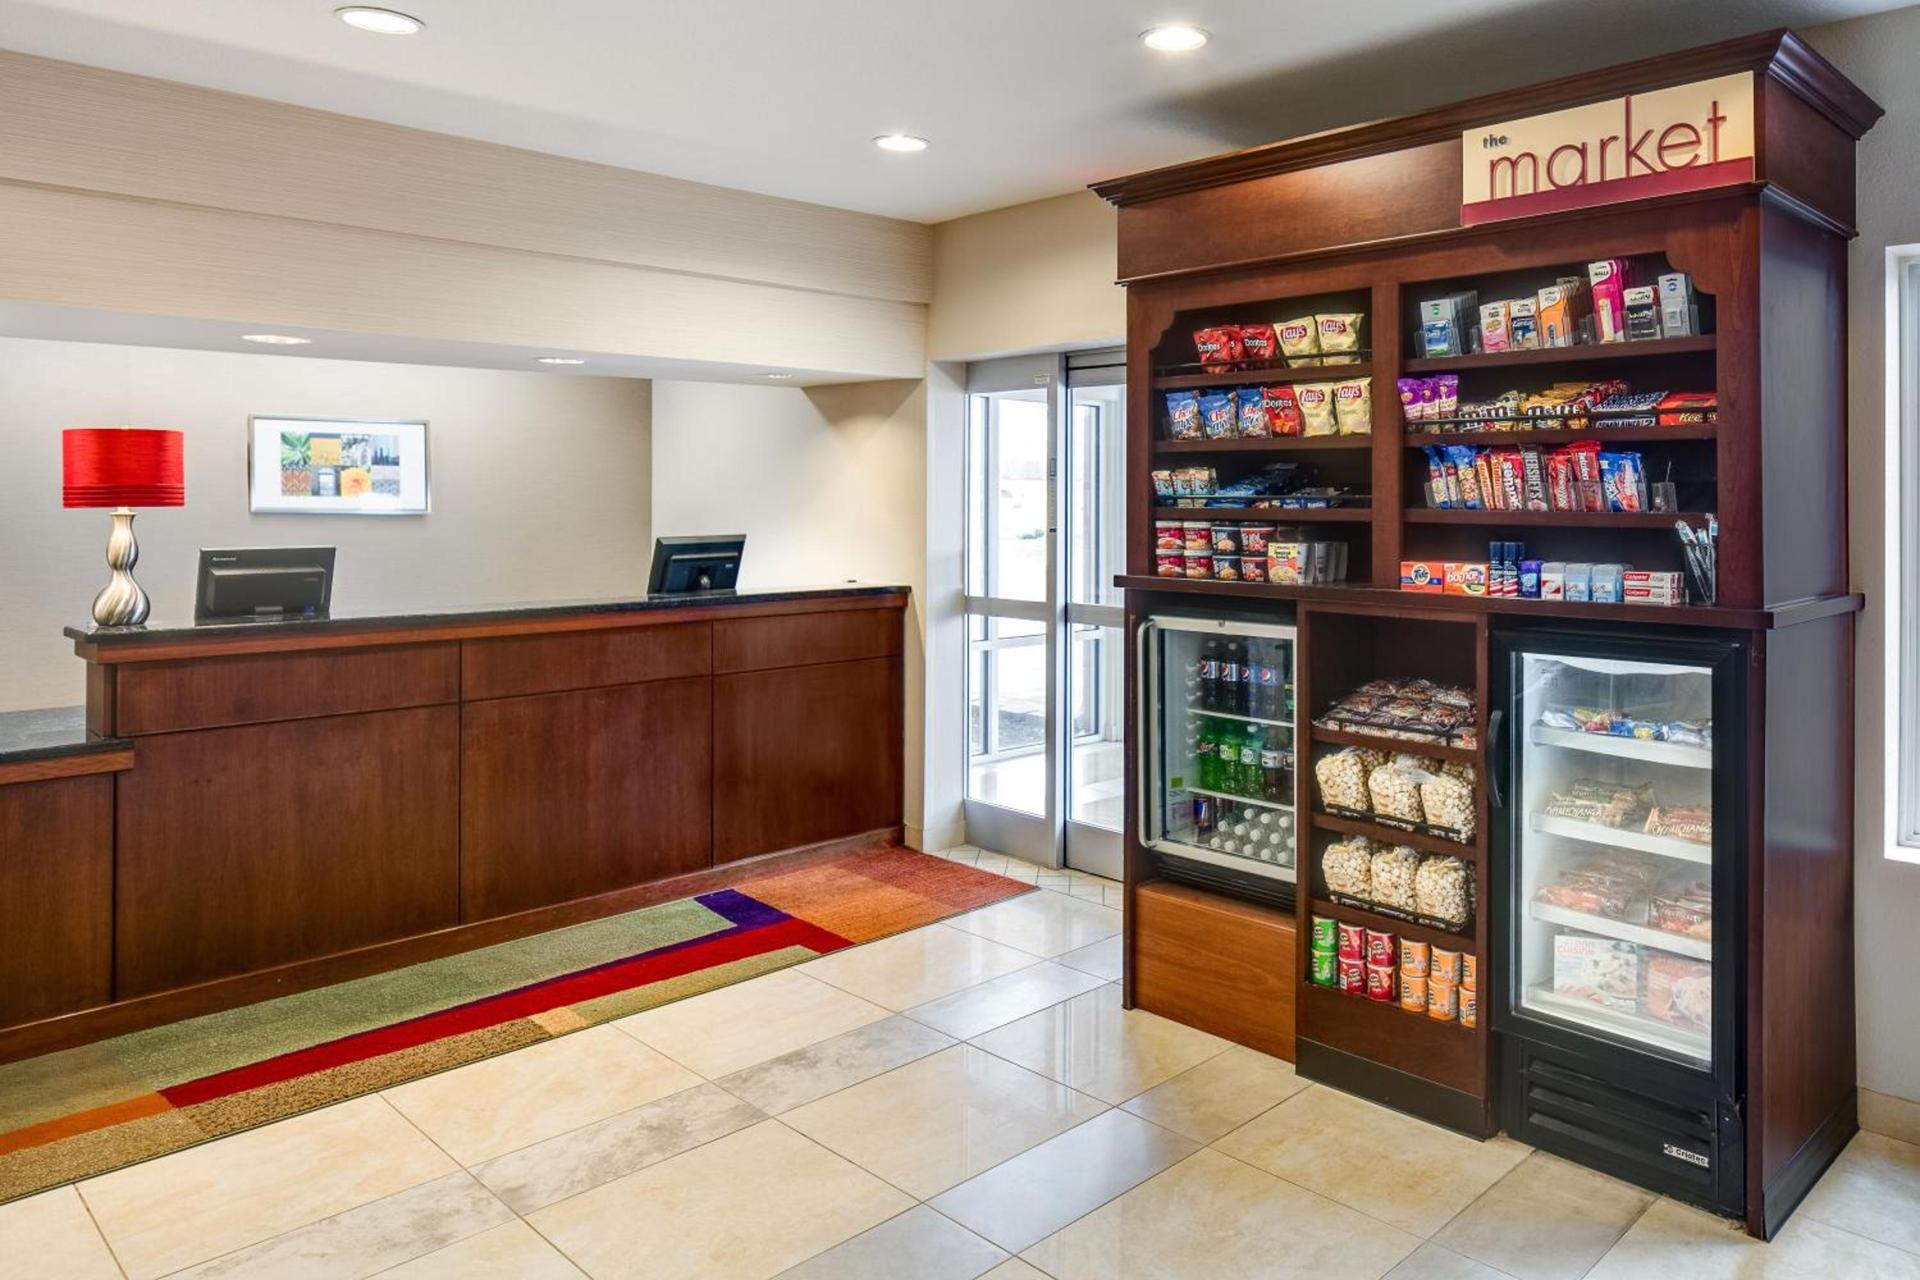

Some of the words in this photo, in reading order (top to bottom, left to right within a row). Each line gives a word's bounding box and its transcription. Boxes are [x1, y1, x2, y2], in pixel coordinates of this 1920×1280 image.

[1482, 133, 1509, 149] the
[1490, 95, 1728, 200] market
[1197, 342, 1221, 353] Doritos
[1243, 338, 1268, 347] Doritos
[1262, 399, 1293, 409] Doritos
[1523, 451, 1543, 499] HERSHEY'S
[1503, 460, 1523, 512] Skittles
[1413, 569, 1429, 581] Tide
[1625, 573, 1650, 581] Colgate
